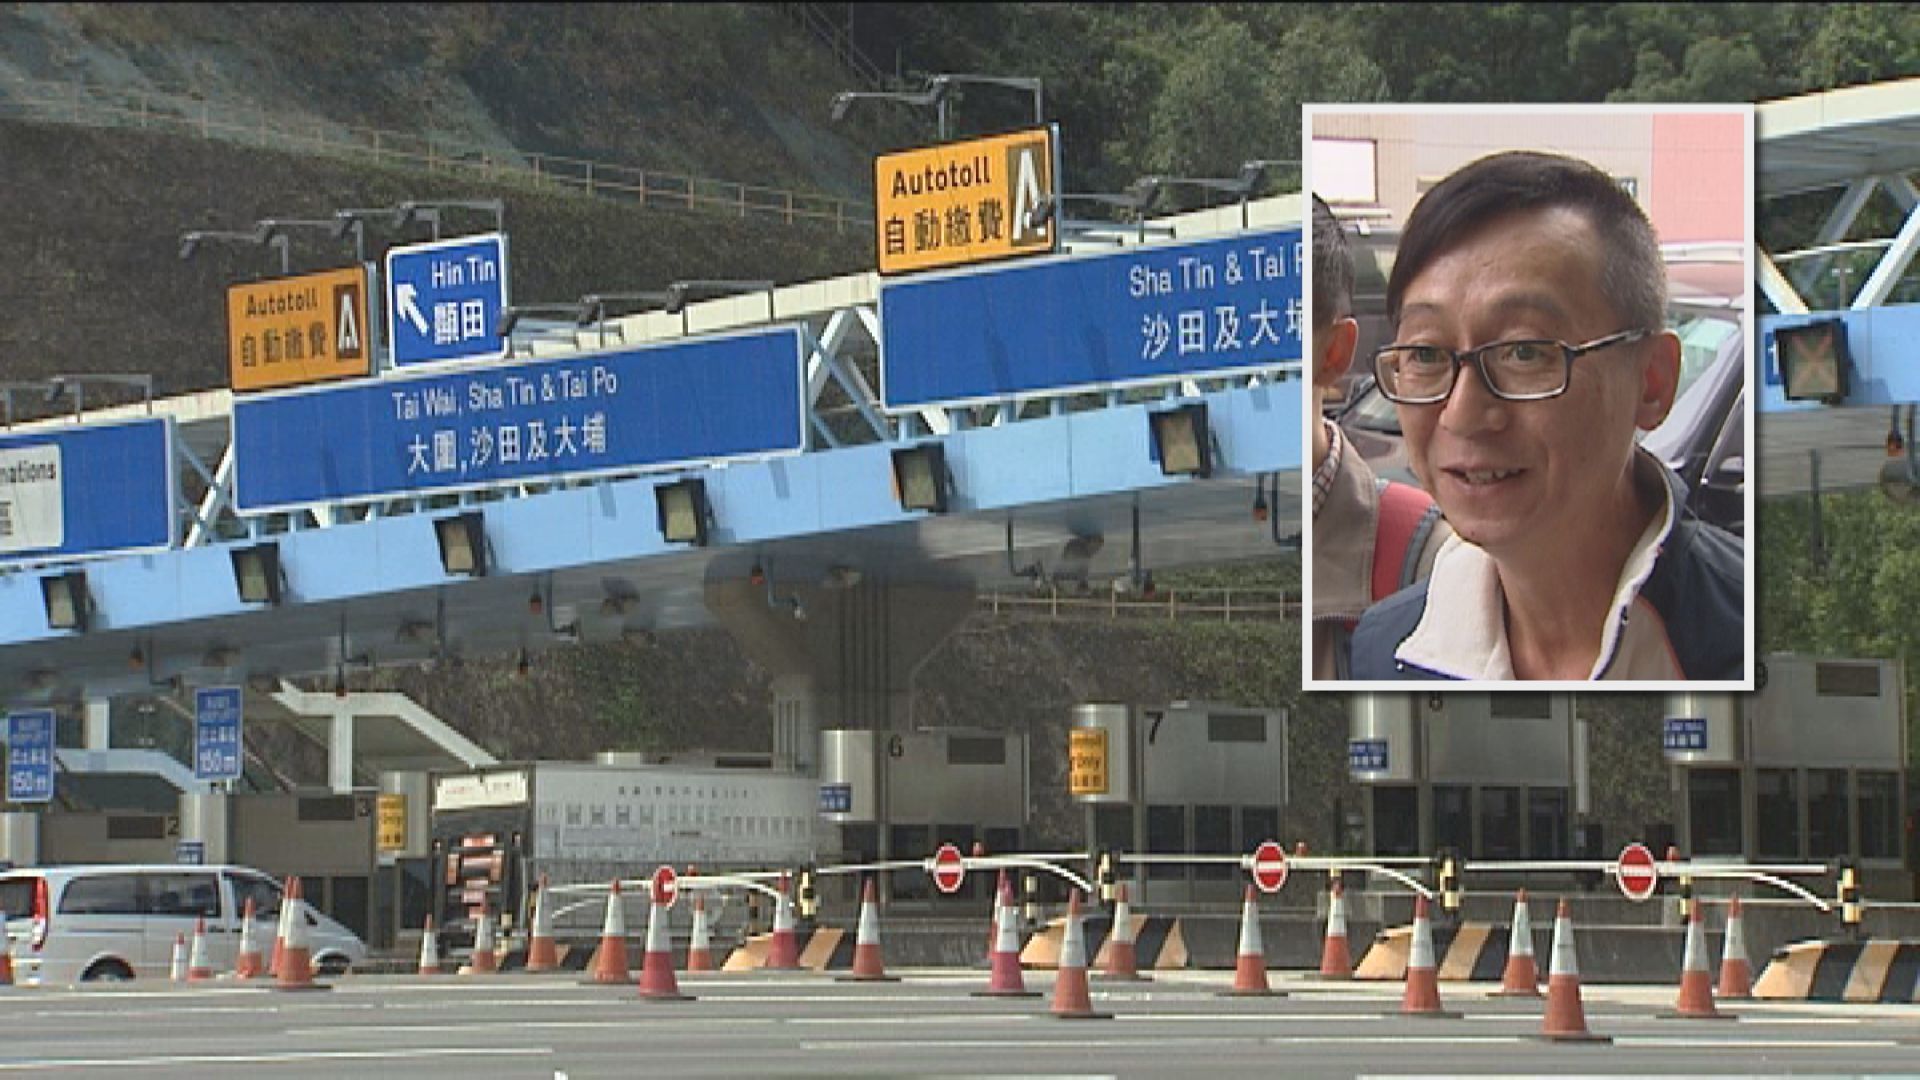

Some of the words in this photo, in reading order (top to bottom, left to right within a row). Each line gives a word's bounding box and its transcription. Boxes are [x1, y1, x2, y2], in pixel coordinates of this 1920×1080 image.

[892, 156, 990, 198] Autotoll
[885, 198, 1004, 255] 自動繳費
[431, 260, 465, 289] Hin
[466, 255, 496, 284] Tin
[1129, 263, 1173, 297] Sha
[1178, 255, 1215, 291] Tin
[1225, 250, 1243, 285] &
[1248, 245, 1285, 281] Tai
[246, 288, 318, 316] Autotoll
[241, 322, 327, 367] 自動繳費
[391, 391, 419, 420] Tai
[468, 379, 503, 412] Sha
[506, 376, 537, 405] Tin
[541, 373, 555, 402] &
[559, 368, 588, 399] Tai
[593, 364, 618, 397] Po
[1144, 710, 1164, 744] 7
[167, 816, 180, 836] 2
